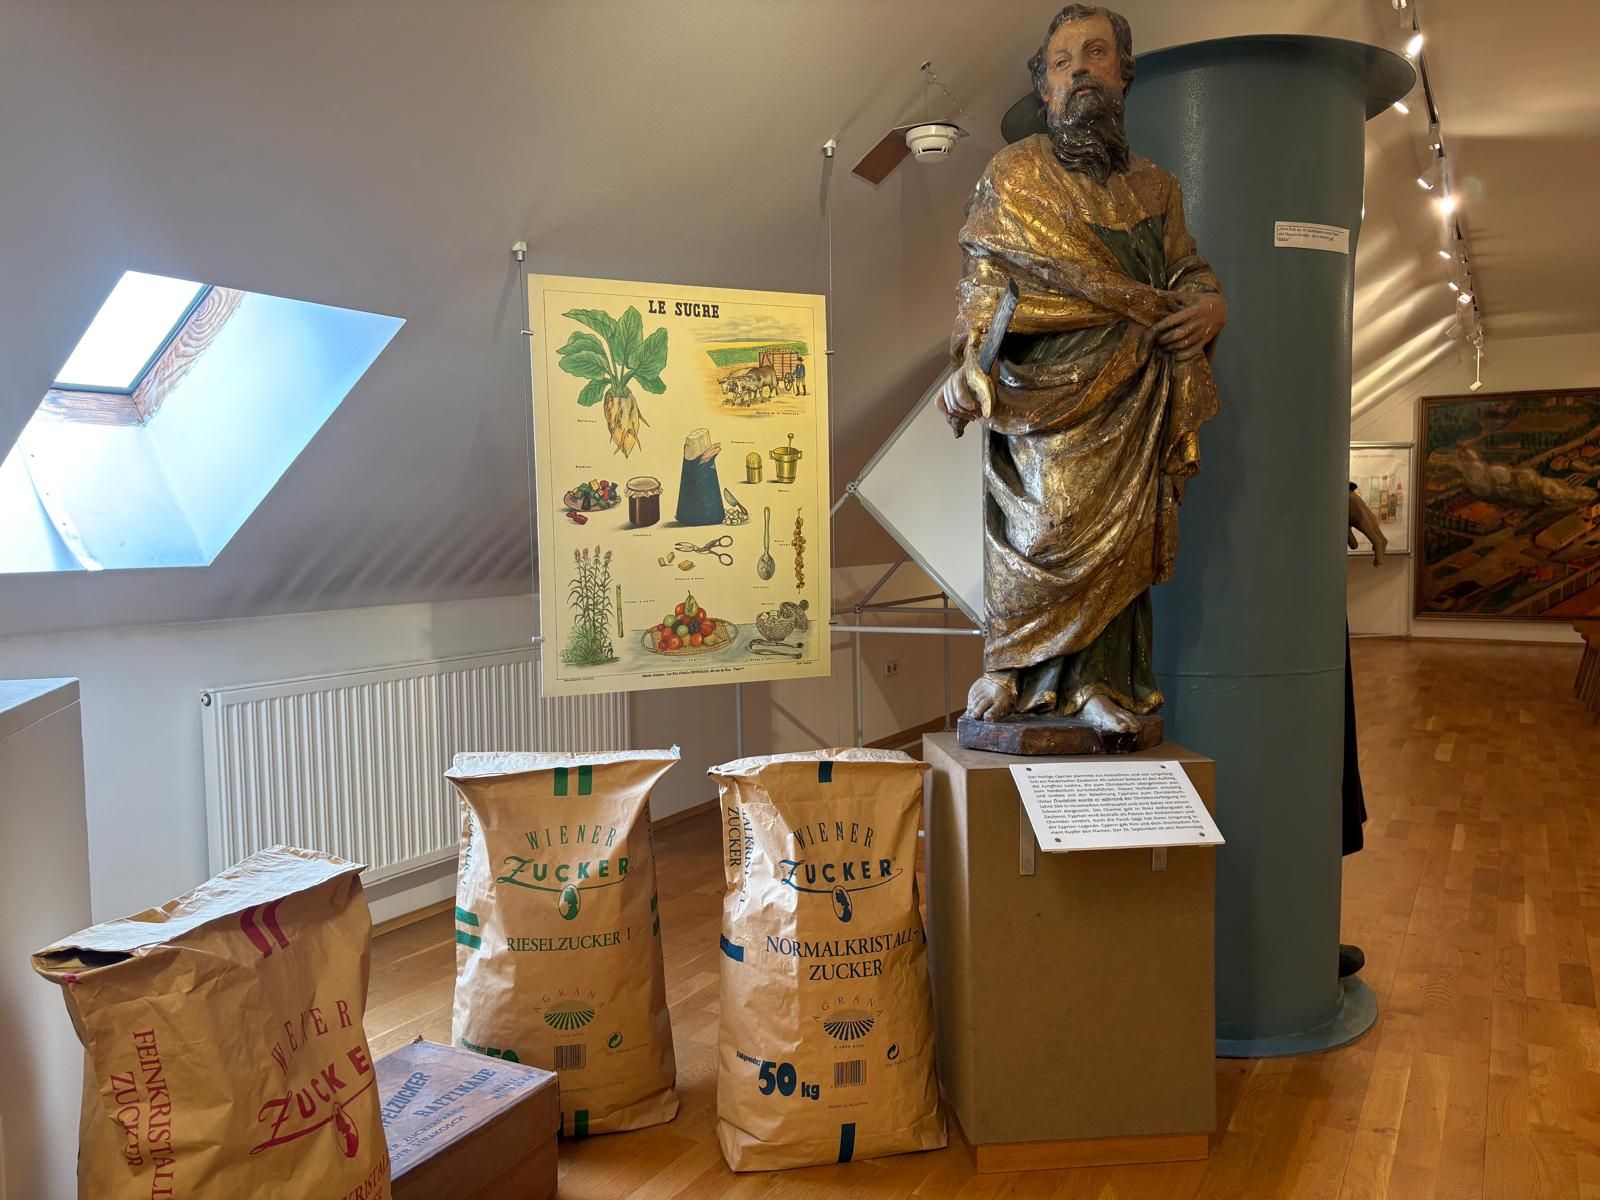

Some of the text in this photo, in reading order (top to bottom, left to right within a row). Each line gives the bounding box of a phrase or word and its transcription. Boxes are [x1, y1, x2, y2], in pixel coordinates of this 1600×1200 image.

[648, 300, 666, 315] LE
[524, 825, 616, 850] WIENER
[728, 807, 742, 867] ZUCKER
[793, 821, 874, 850] WIENER
[497, 855, 631, 884] ZUCKER
[779, 859, 893, 885] ZUCKER
[506, 932, 621, 952] RIESELZUCKER
[766, 928, 918, 958] NORMALKRISTALL-
[809, 959, 882, 980] ZUCKER
[532, 988, 606, 1013] AGRANA
[813, 996, 884, 1022] AGRANA
[412, 1068, 498, 1117] RAFFINADE
[758, 1060, 820, 1100] 50 kg
[250, 1046, 370, 1154] ZUCKE
[383, 1072, 432, 1128] FELZUCKER
